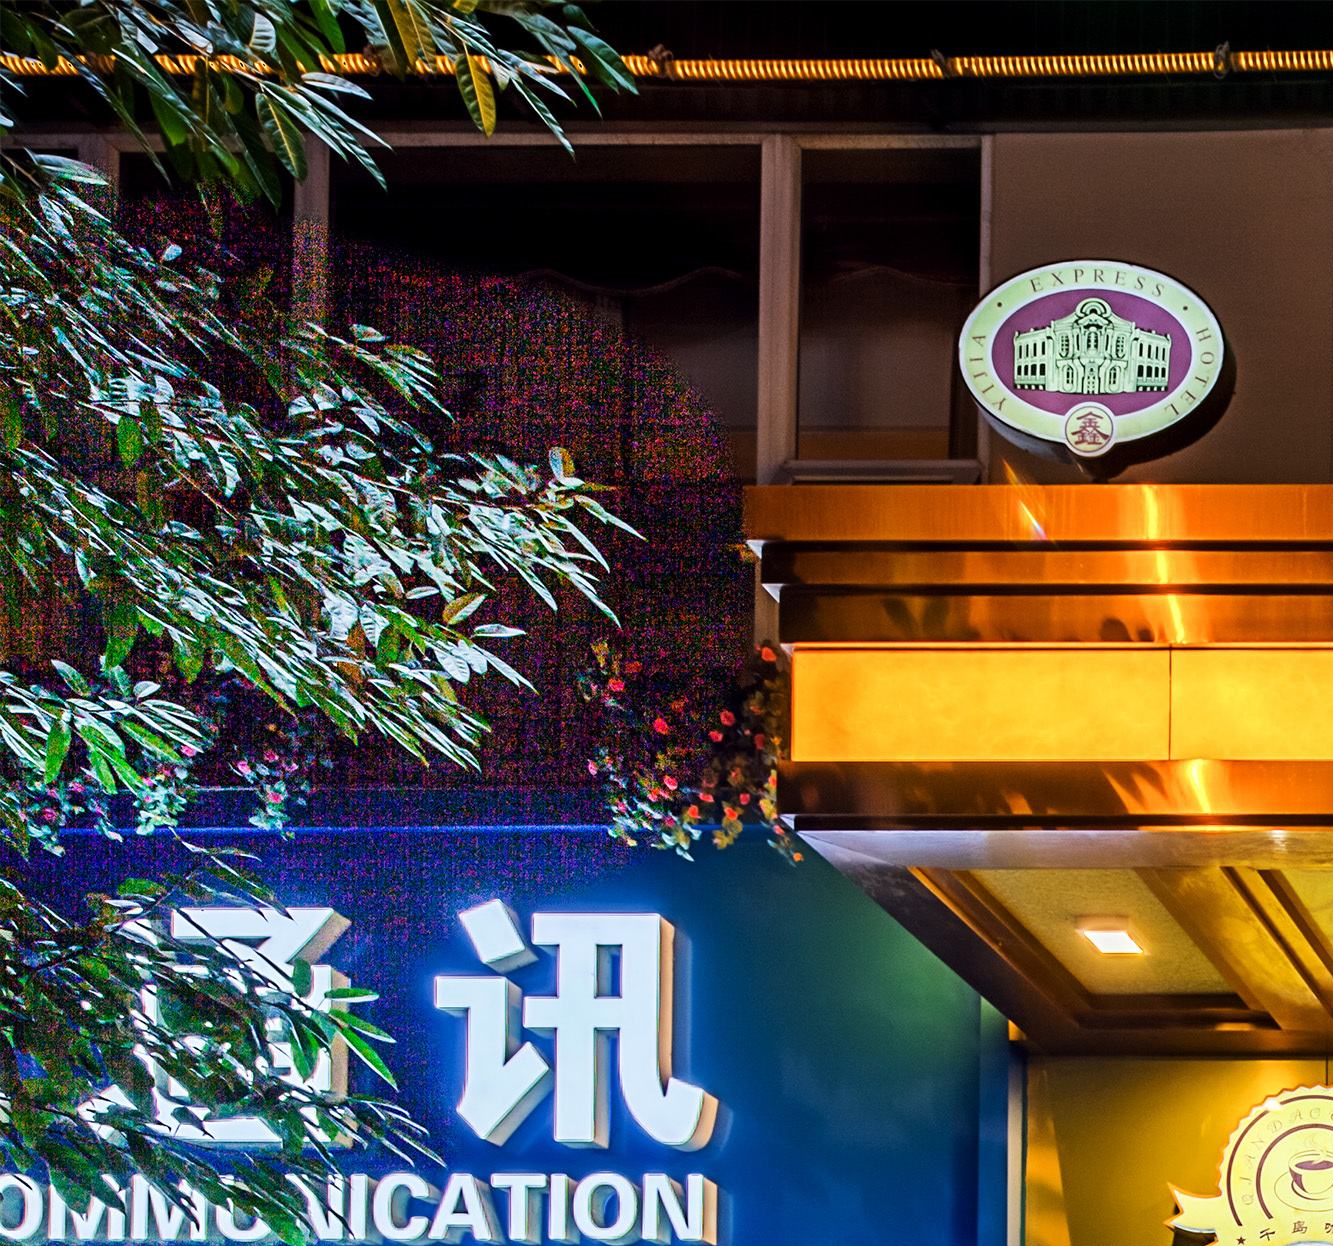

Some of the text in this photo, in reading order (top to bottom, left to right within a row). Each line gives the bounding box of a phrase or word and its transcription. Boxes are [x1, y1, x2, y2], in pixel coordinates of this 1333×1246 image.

[969, 268, 1215, 416] YIJIA EXPRESS HOTEL
[1071, 411, 1109, 446] 鑫
